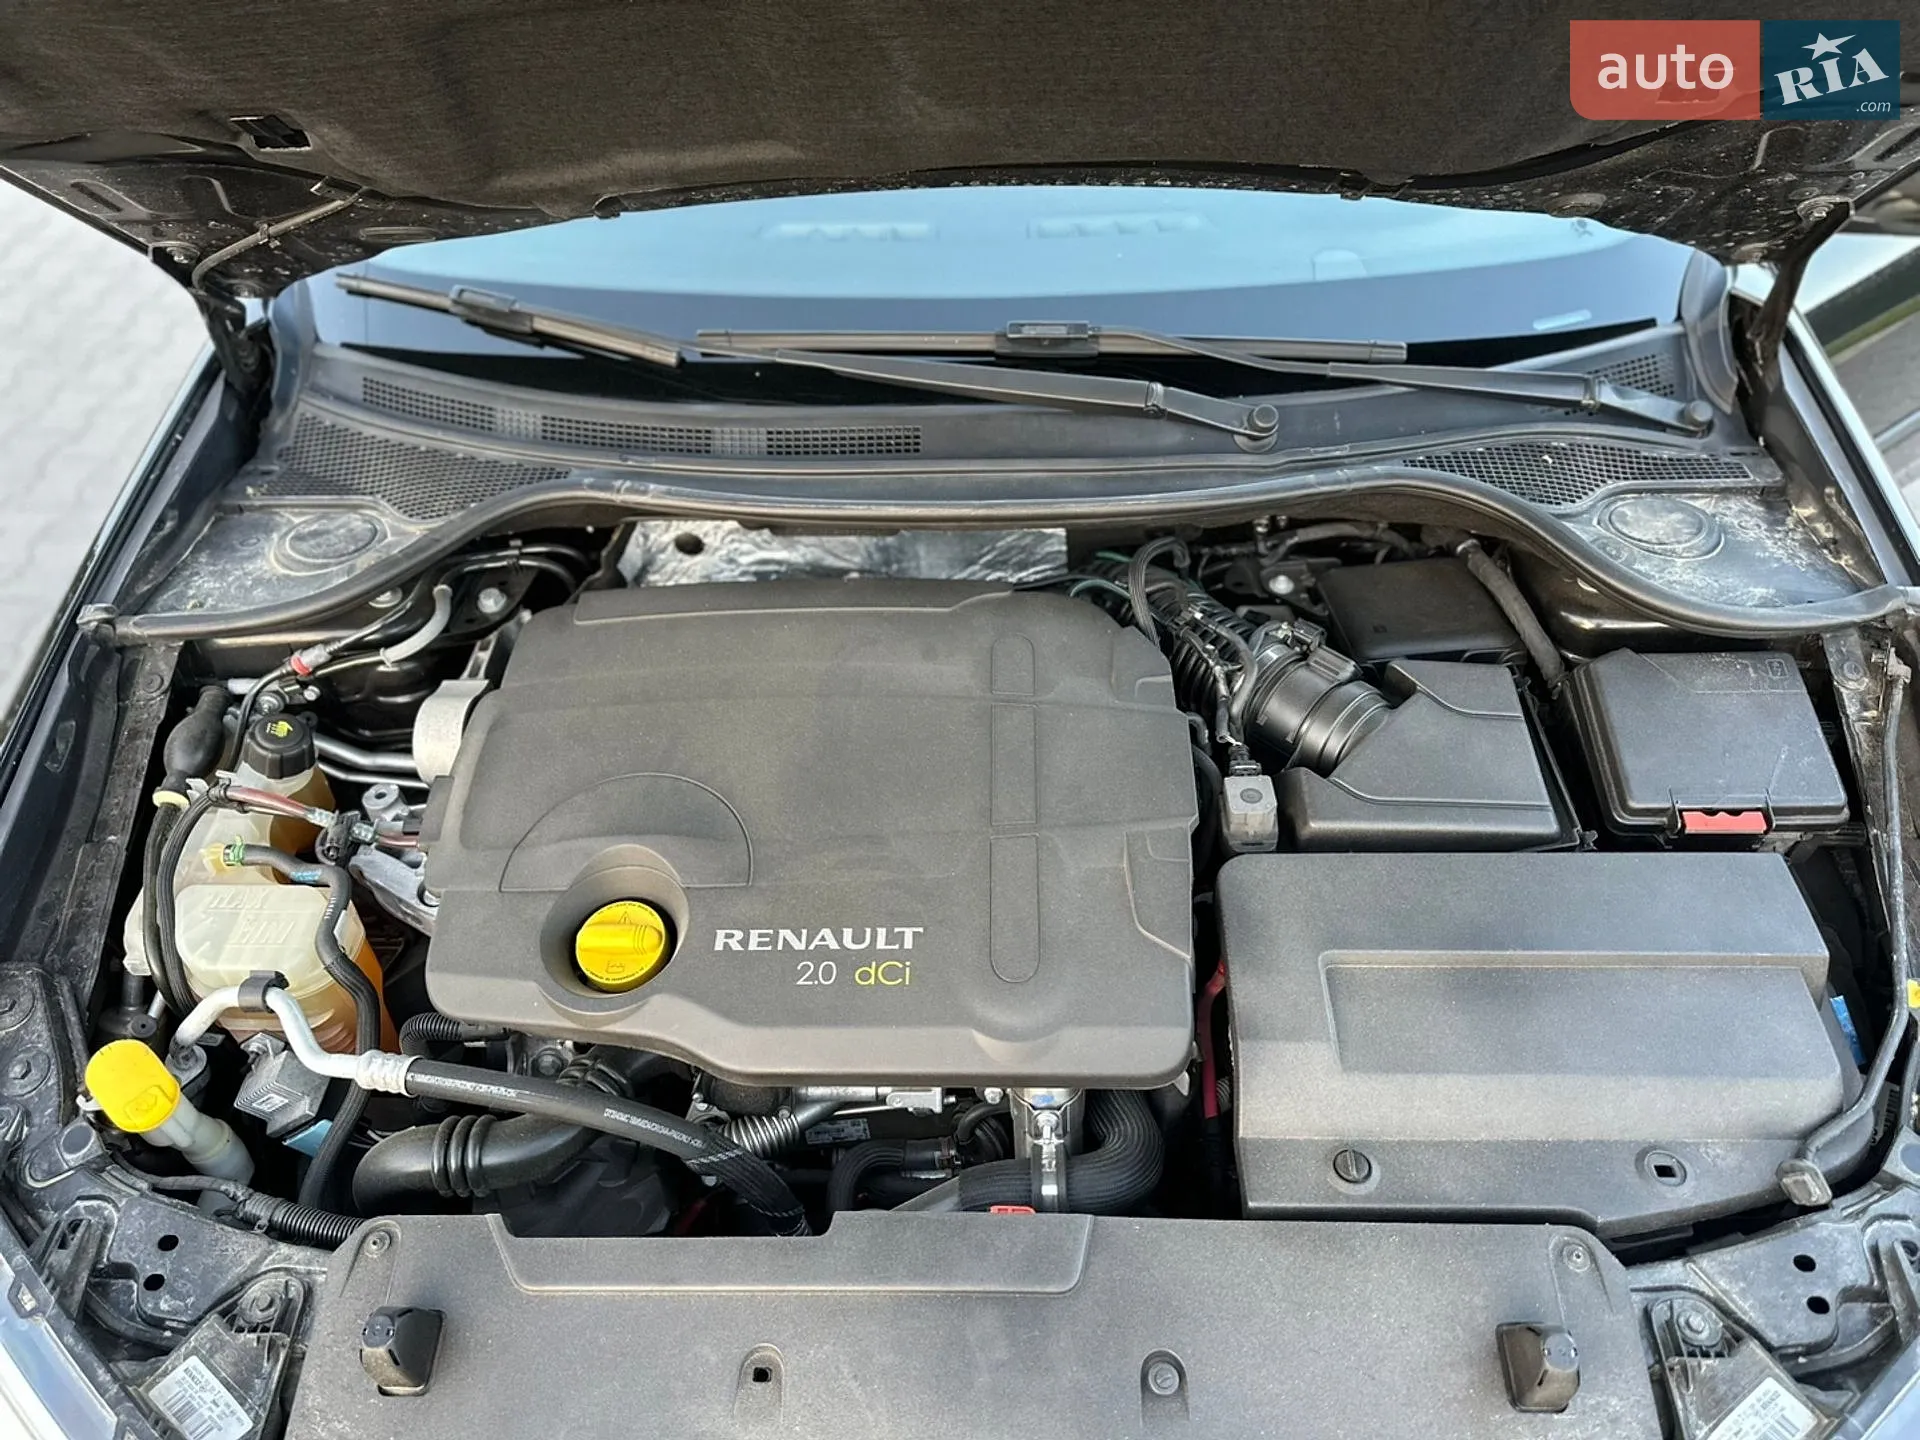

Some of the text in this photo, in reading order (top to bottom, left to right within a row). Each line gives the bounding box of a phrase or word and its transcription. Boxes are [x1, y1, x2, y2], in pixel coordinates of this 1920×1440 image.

[714, 927, 924, 951] RENAULT
[796, 961, 911, 985] 2.0 dCi
